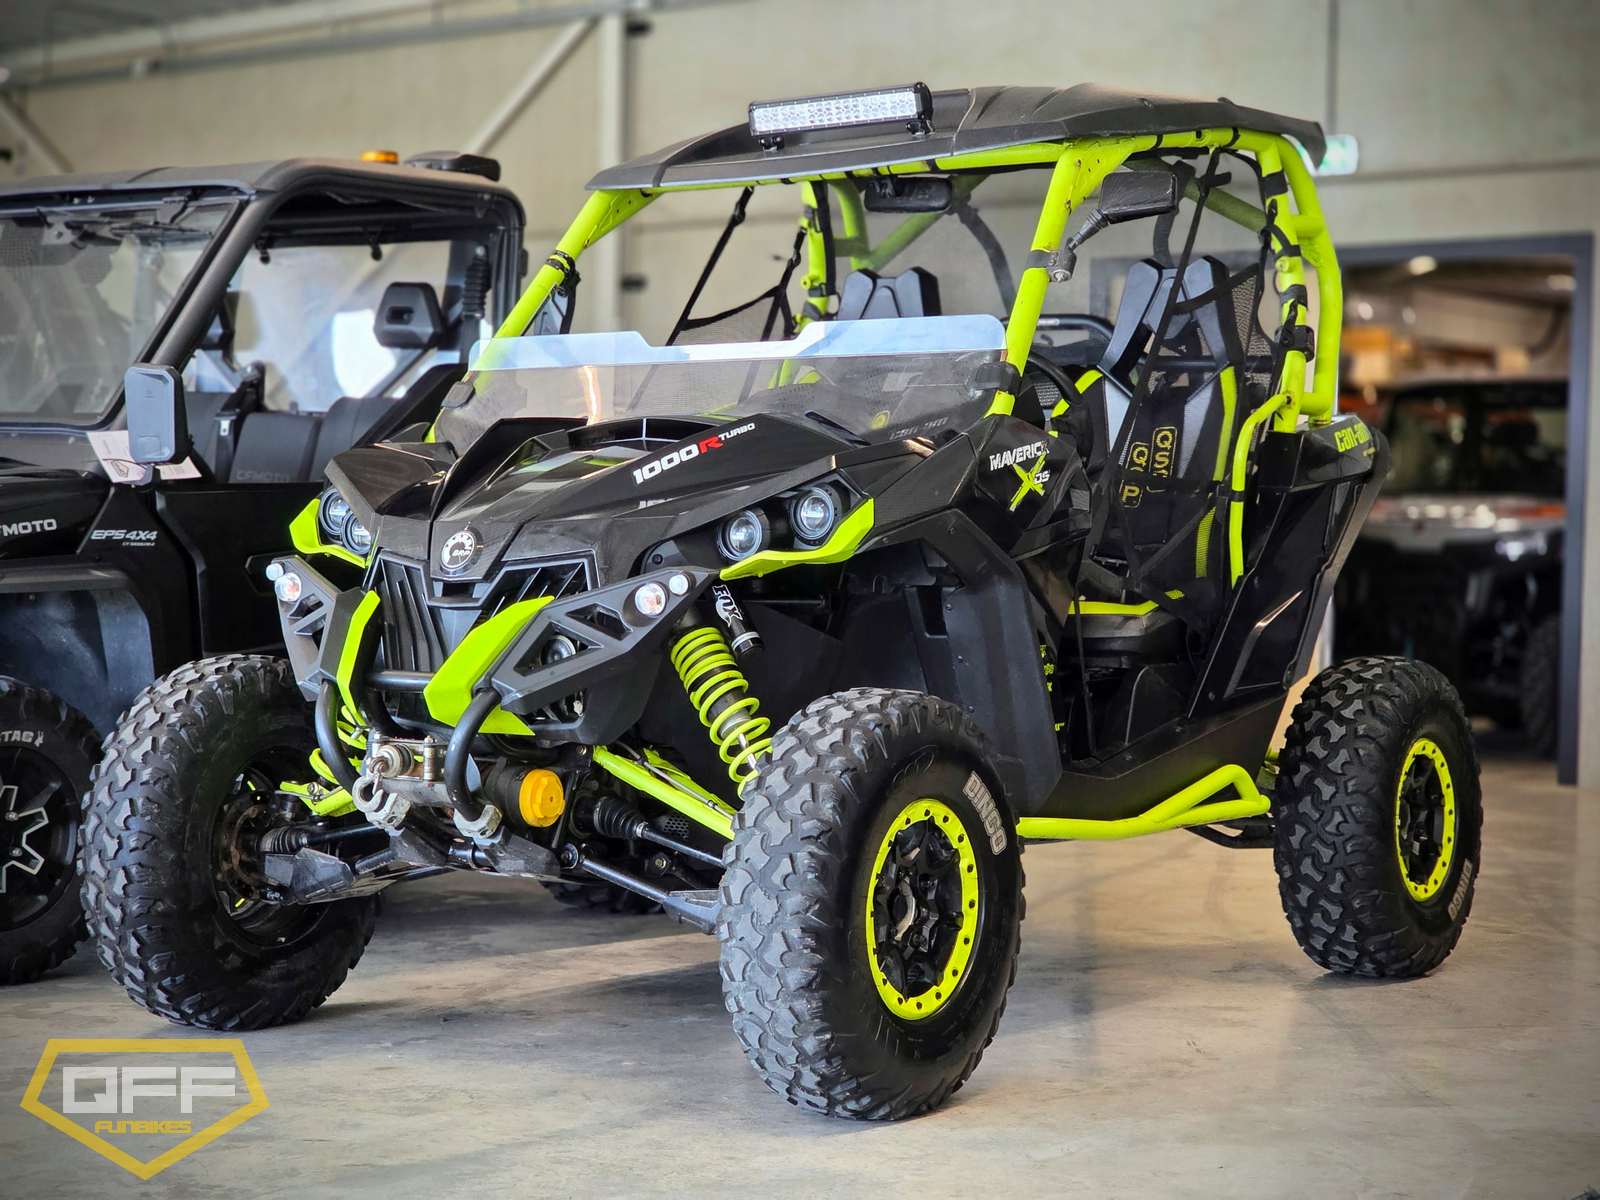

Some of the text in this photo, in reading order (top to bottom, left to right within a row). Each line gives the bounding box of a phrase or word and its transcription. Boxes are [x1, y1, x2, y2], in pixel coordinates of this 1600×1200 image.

[719, 421, 756, 441] TURBO
[989, 440, 1050, 472] MAVERICK
[0, 518, 57, 536] MOTO
[712, 584, 743, 624] FOX
[0, 730, 35, 743] TAG
[962, 770, 1008, 856] DINGO
